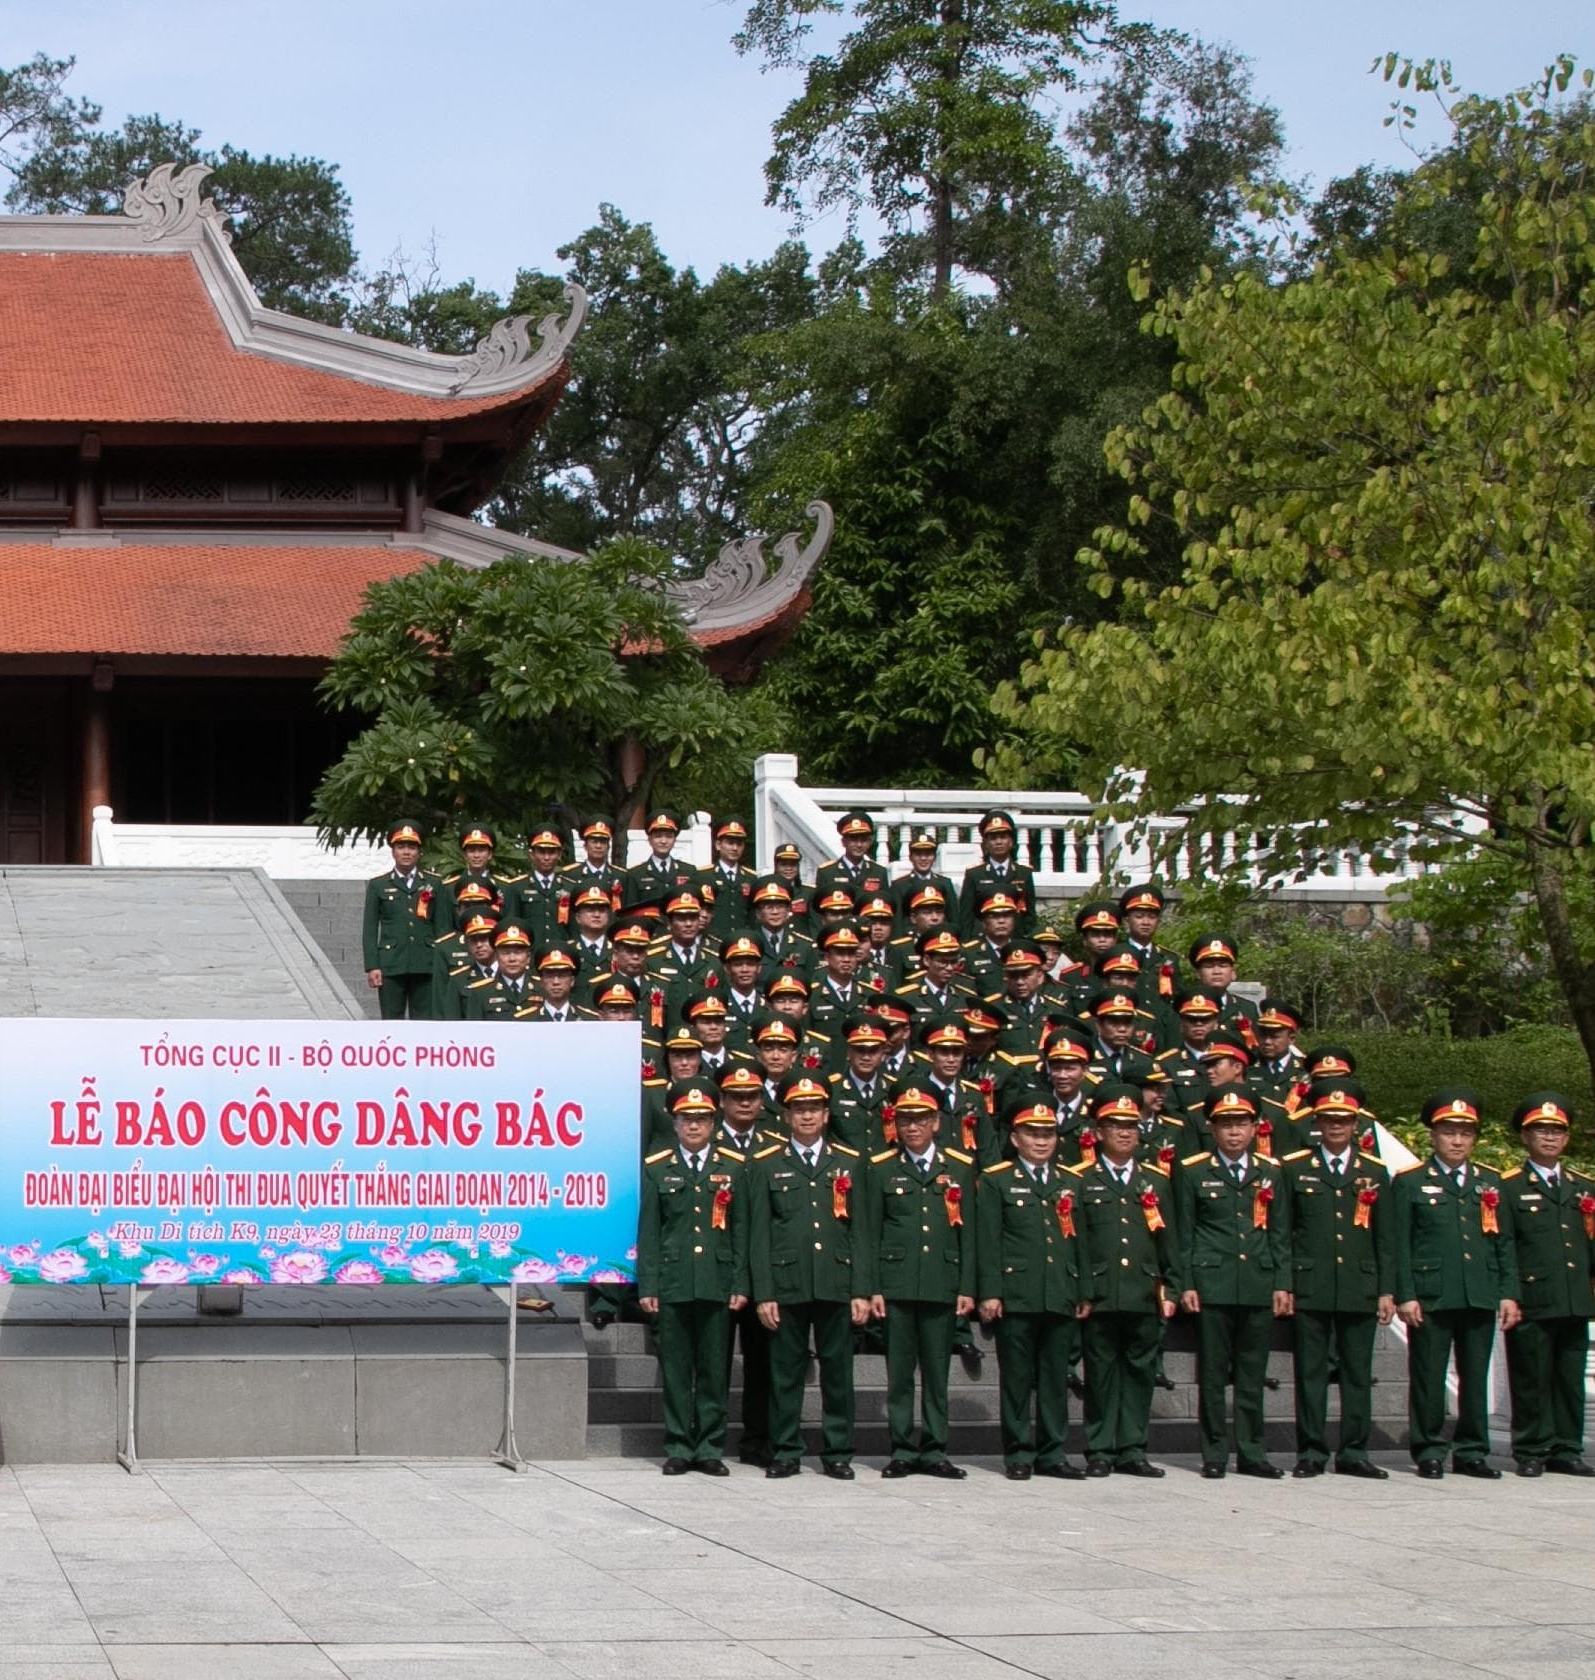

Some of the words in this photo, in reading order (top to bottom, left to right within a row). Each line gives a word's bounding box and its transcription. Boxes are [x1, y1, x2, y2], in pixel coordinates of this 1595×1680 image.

[140, 1032, 204, 1067] TỔNG
[212, 1045, 261, 1074] CỤC
[268, 1046, 281, 1067] II
[302, 1040, 333, 1074] BỘ
[341, 1035, 407, 1067] QUỐC
[415, 1040, 496, 1067] PHÒNG
[50, 1076, 103, 1145] LỄ
[115, 1087, 206, 1146] BÁO
[220, 1086, 342, 1146] CÔNG
[355, 1087, 483, 1146] DÂNG
[495, 1088, 583, 1146] BÁC
[26, 1166, 72, 1206] ĐOÀN
[78, 1173, 108, 1213] ĐẠI
[113, 1159, 152, 1206] BIỂU
[157, 1173, 186, 1213] ĐẠI
[192, 1167, 220, 1213] HỘI
[226, 1173, 251, 1206] THI
[257, 1173, 292, 1206] ĐUA
[297, 1161, 350, 1209] QUYẾT
[355, 1162, 411, 1206] THẮNG
[416, 1173, 450, 1206] GIAI
[455, 1173, 502, 1214] ĐOẠN
[508, 1173, 548, 1206] 2014
[565, 1173, 606, 1206] 2019
[115, 1223, 153, 1240] Khu
[161, 1223, 181, 1240] Di
[189, 1222, 225, 1240] tích
[266, 1222, 313, 1244] ngày
[320, 1224, 341, 1240] 23
[347, 1222, 402, 1244] tháng
[407, 1224, 427, 1240] 10
[432, 1221, 473, 1240] năm
[478, 1224, 520, 1240] 2019
